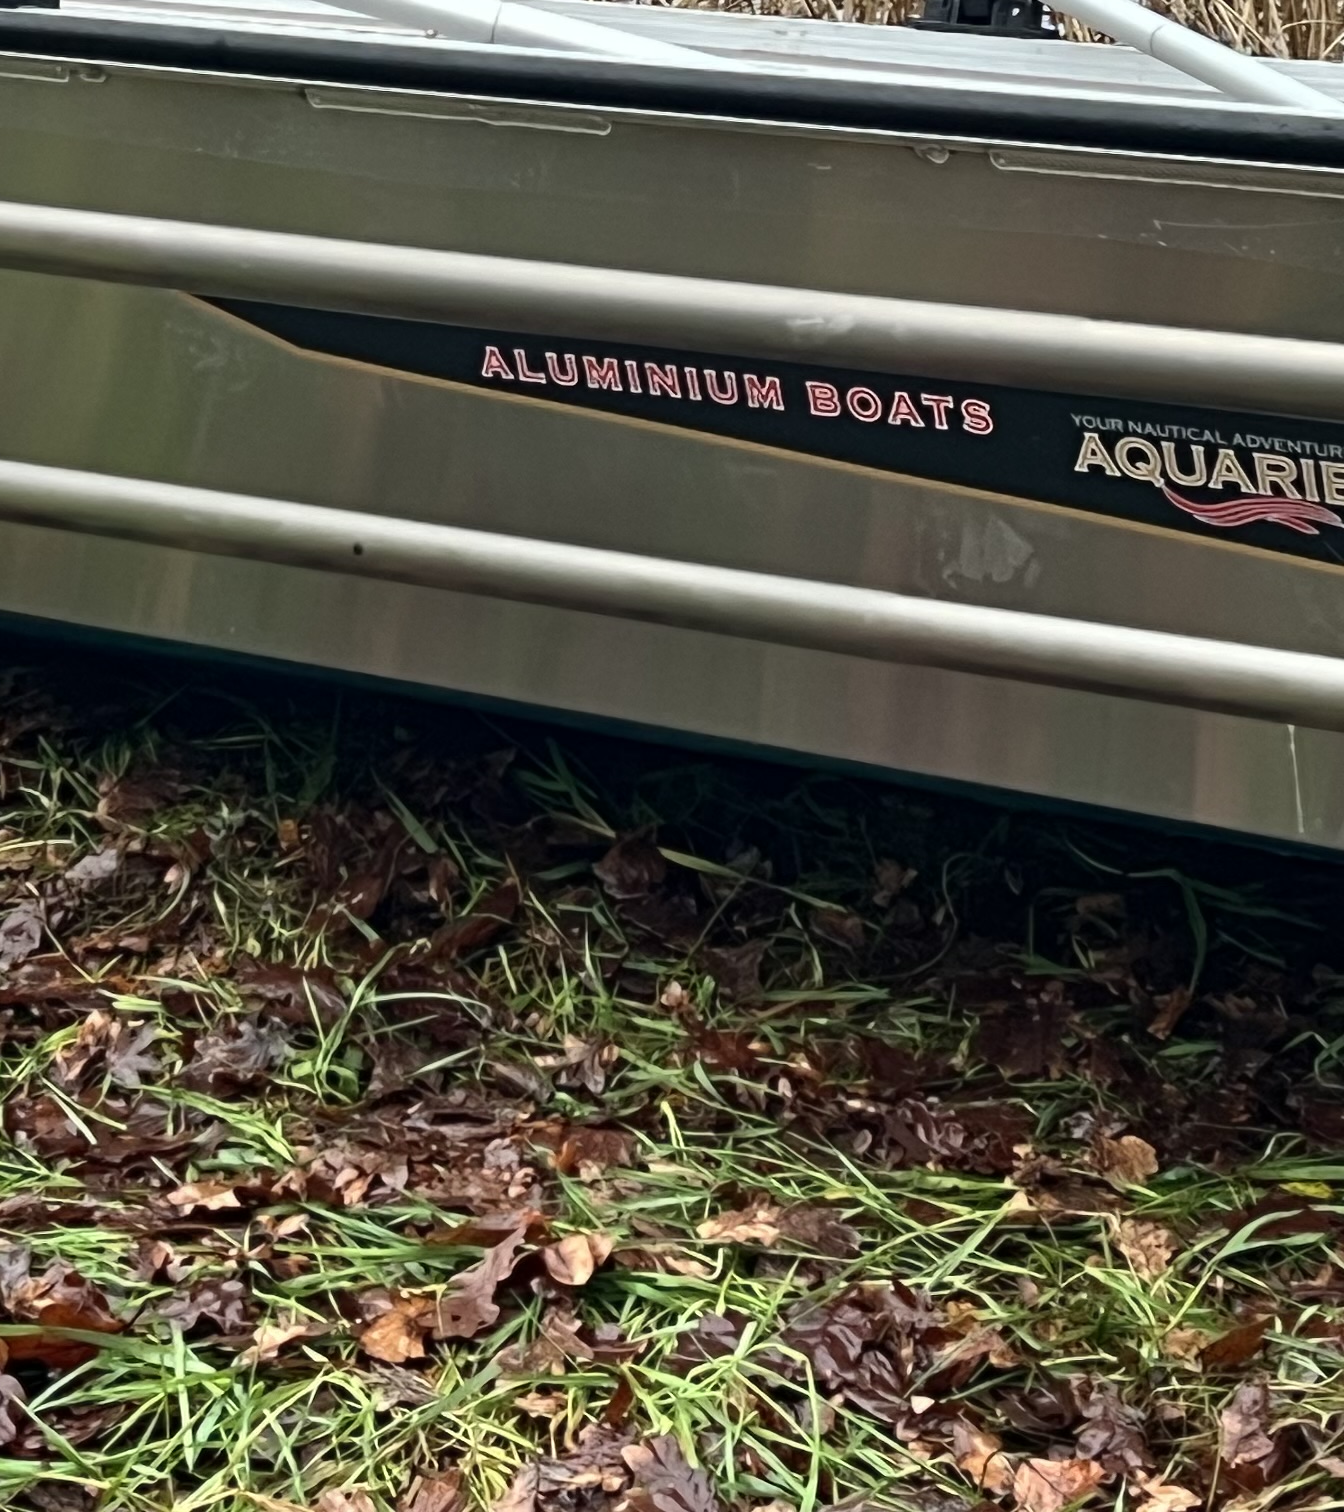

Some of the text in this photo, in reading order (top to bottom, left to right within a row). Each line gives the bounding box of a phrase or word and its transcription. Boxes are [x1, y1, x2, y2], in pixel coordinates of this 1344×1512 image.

[481, 345, 995, 435] ALUMINIUM BOATS
[1071, 413, 1124, 432] YOUR
[1128, 420, 1227, 445] NAUTICAL
